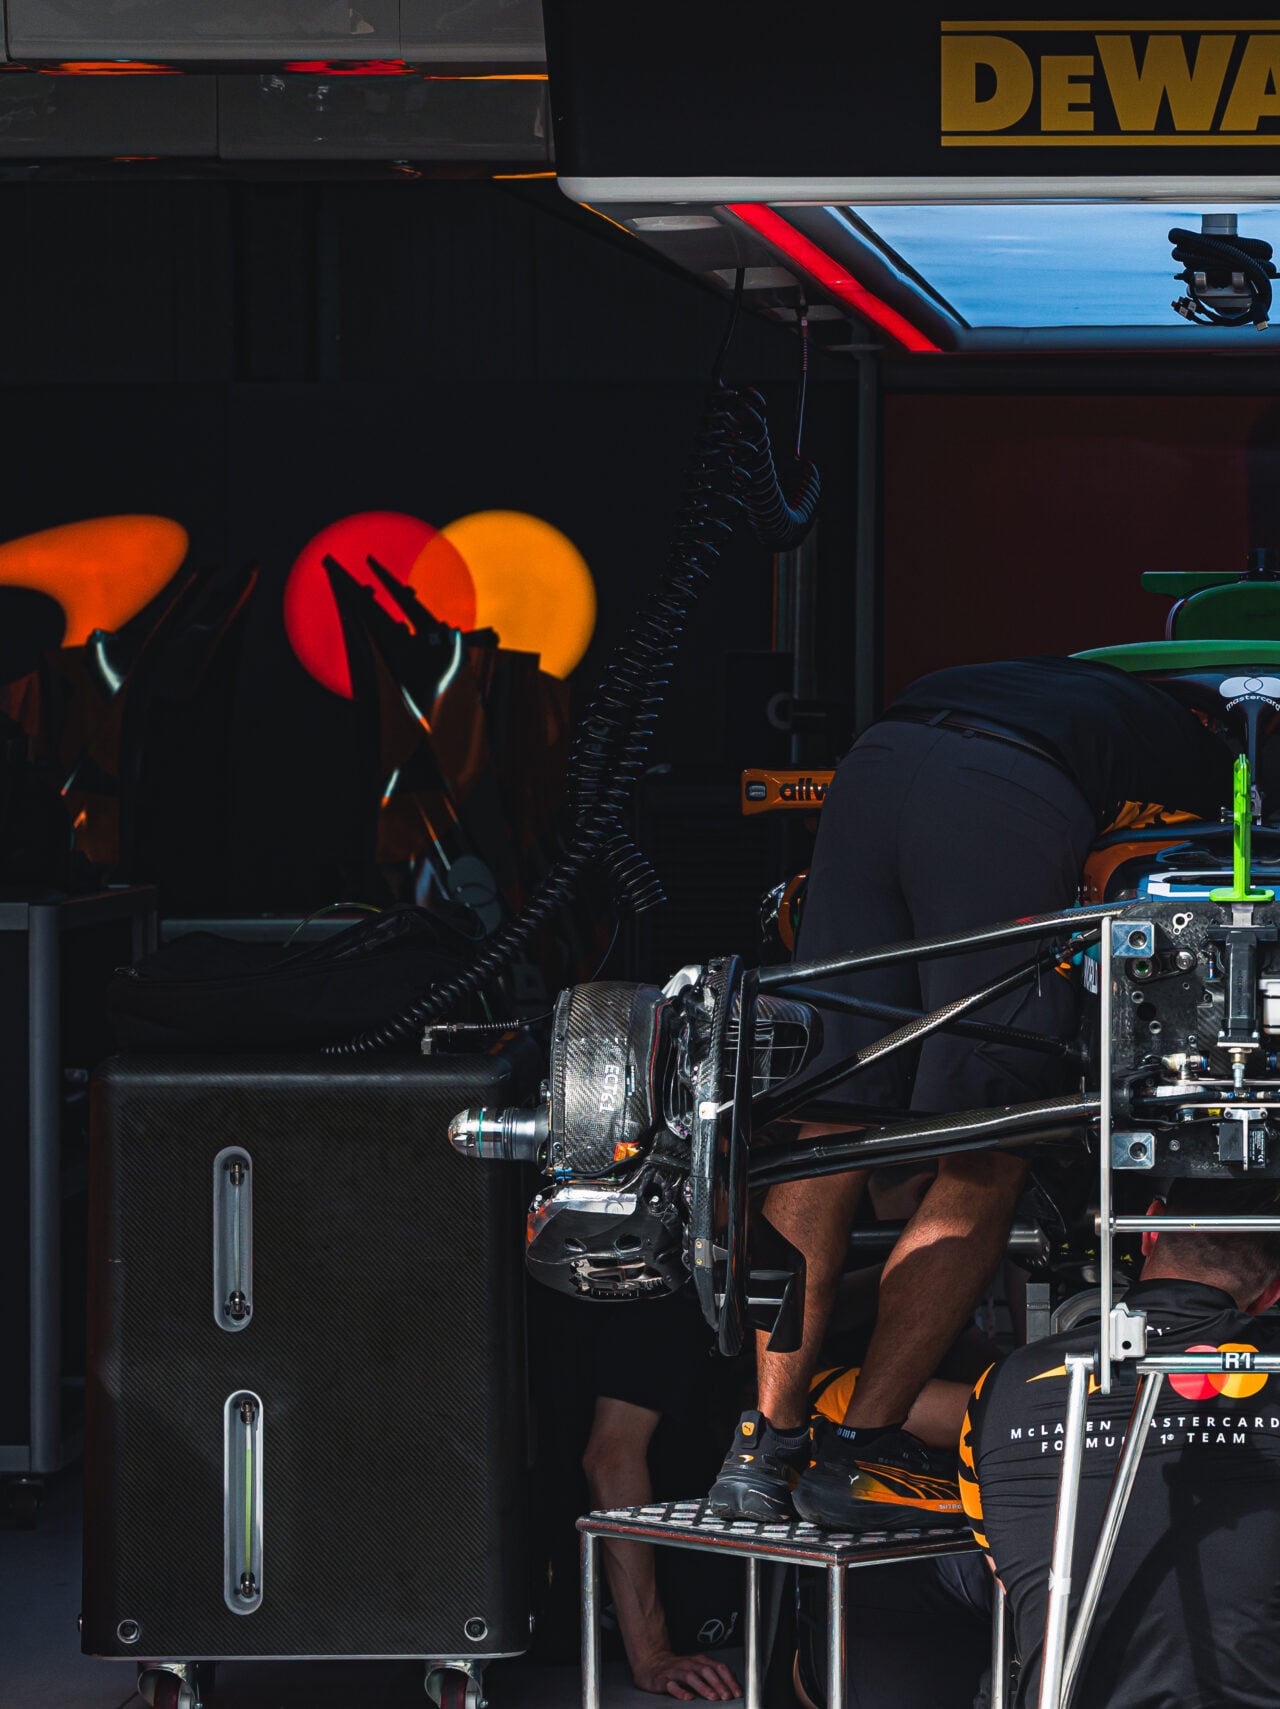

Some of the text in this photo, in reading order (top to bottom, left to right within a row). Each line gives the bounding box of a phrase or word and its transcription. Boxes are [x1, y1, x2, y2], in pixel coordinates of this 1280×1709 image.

[1226, 695, 1280, 711] mastercard
[1225, 1352, 1250, 1369] R1
[1010, 1416, 1280, 1439] McLAEN ASTERCARD
[1186, 1432, 1246, 1444] TEAM
